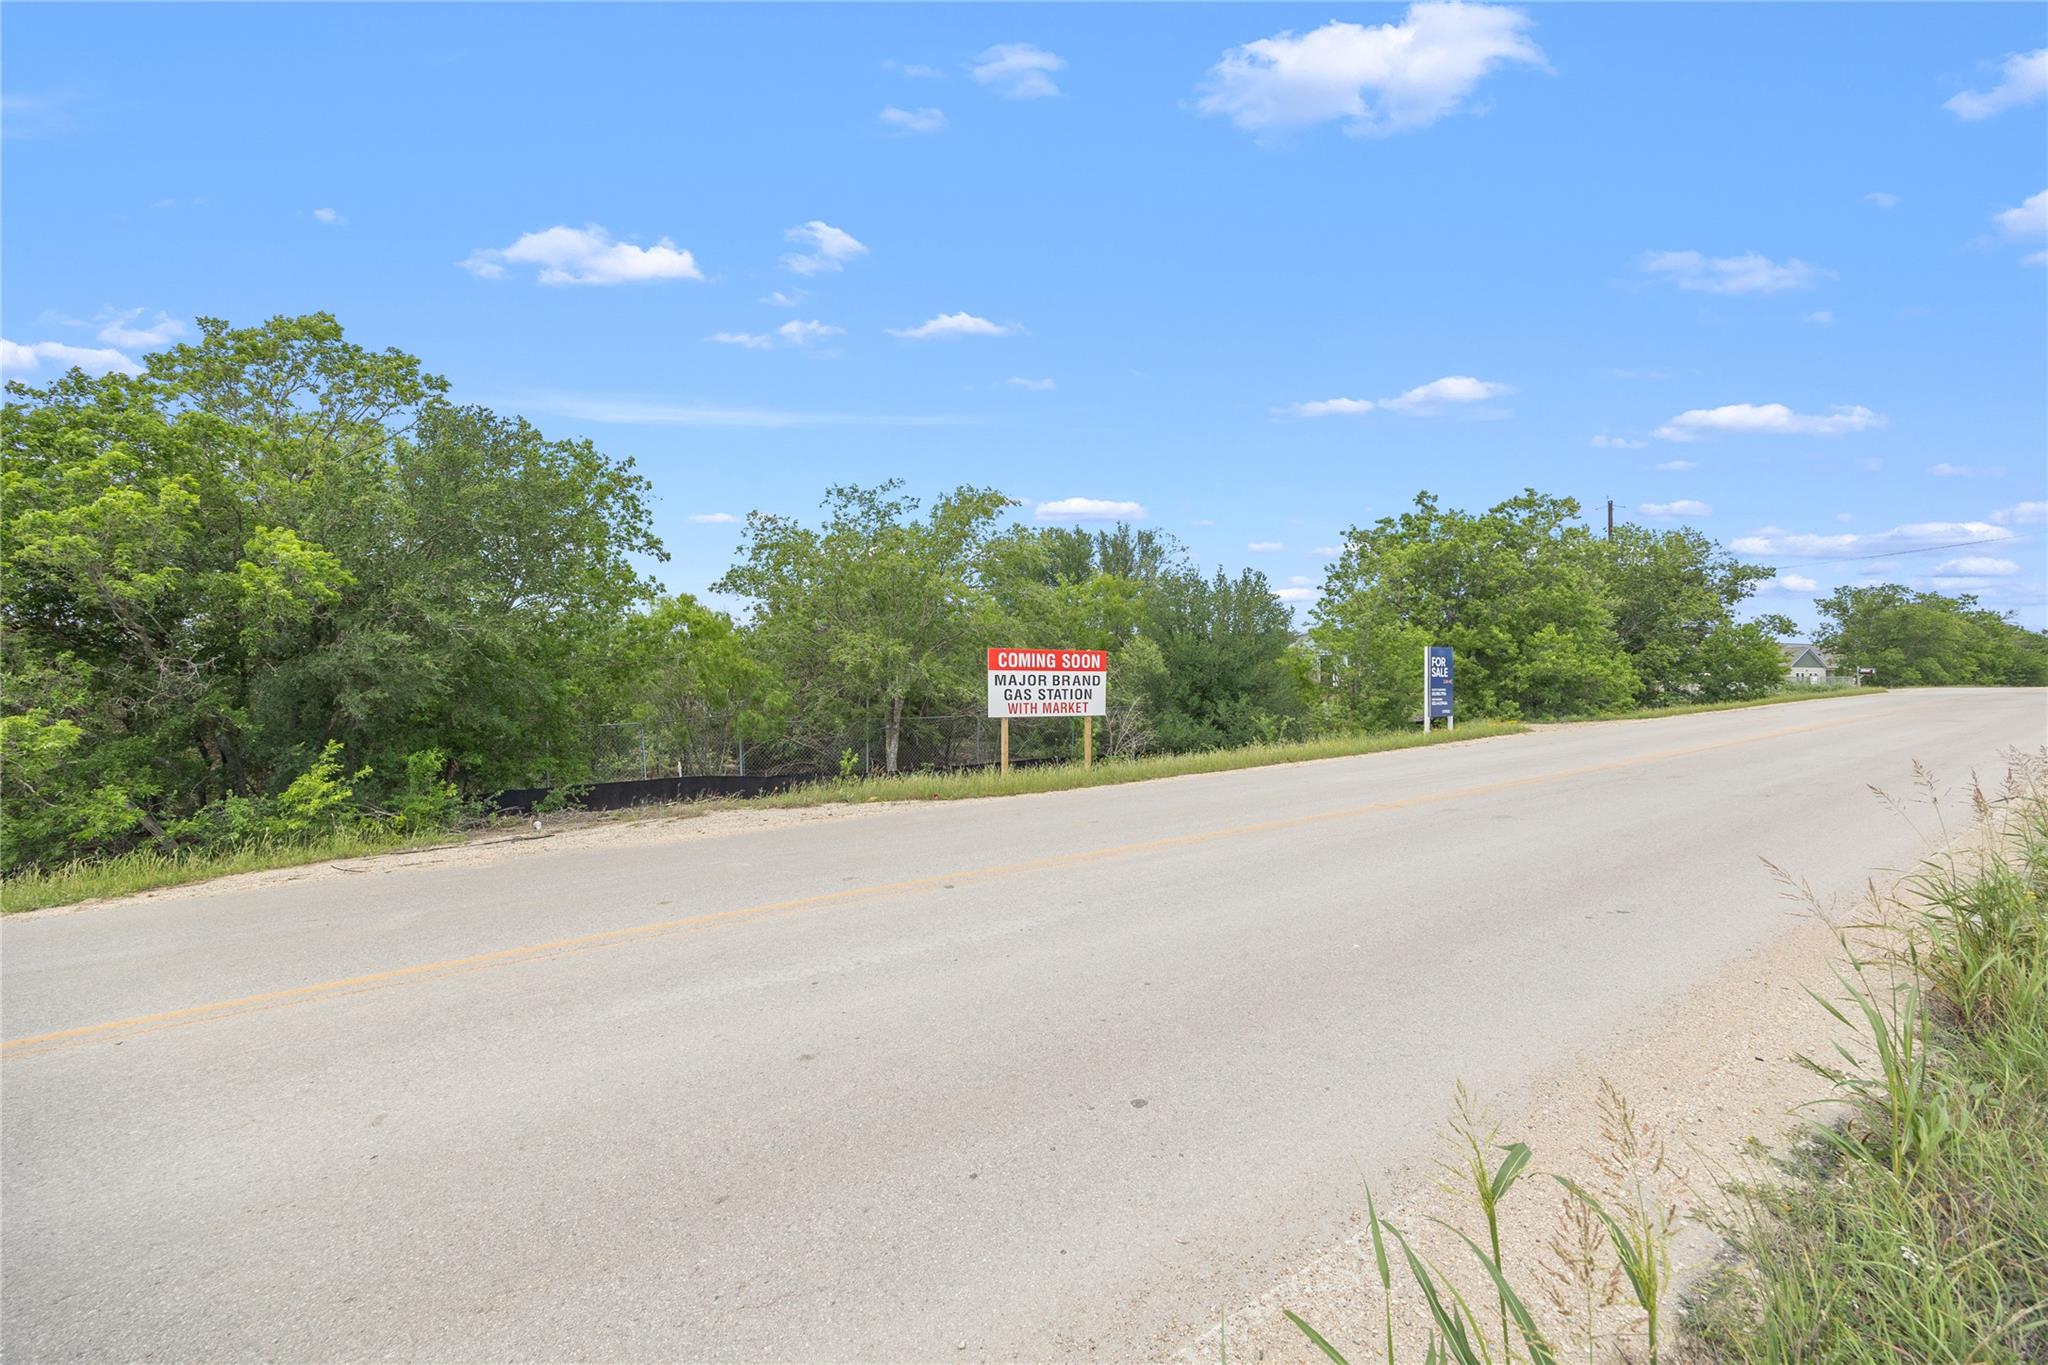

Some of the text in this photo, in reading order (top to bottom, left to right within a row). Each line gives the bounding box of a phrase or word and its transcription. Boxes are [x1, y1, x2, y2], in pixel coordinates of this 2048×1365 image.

[998, 653, 1101, 669] COMING SOON
[1431, 657, 1446, 667] FOR
[1431, 667, 1448, 677] SALE
[994, 675, 1101, 686] MAJOR BRAND
[1004, 689, 1092, 700] GAS STATION
[1008, 702, 1089, 714] WITH MARKET
